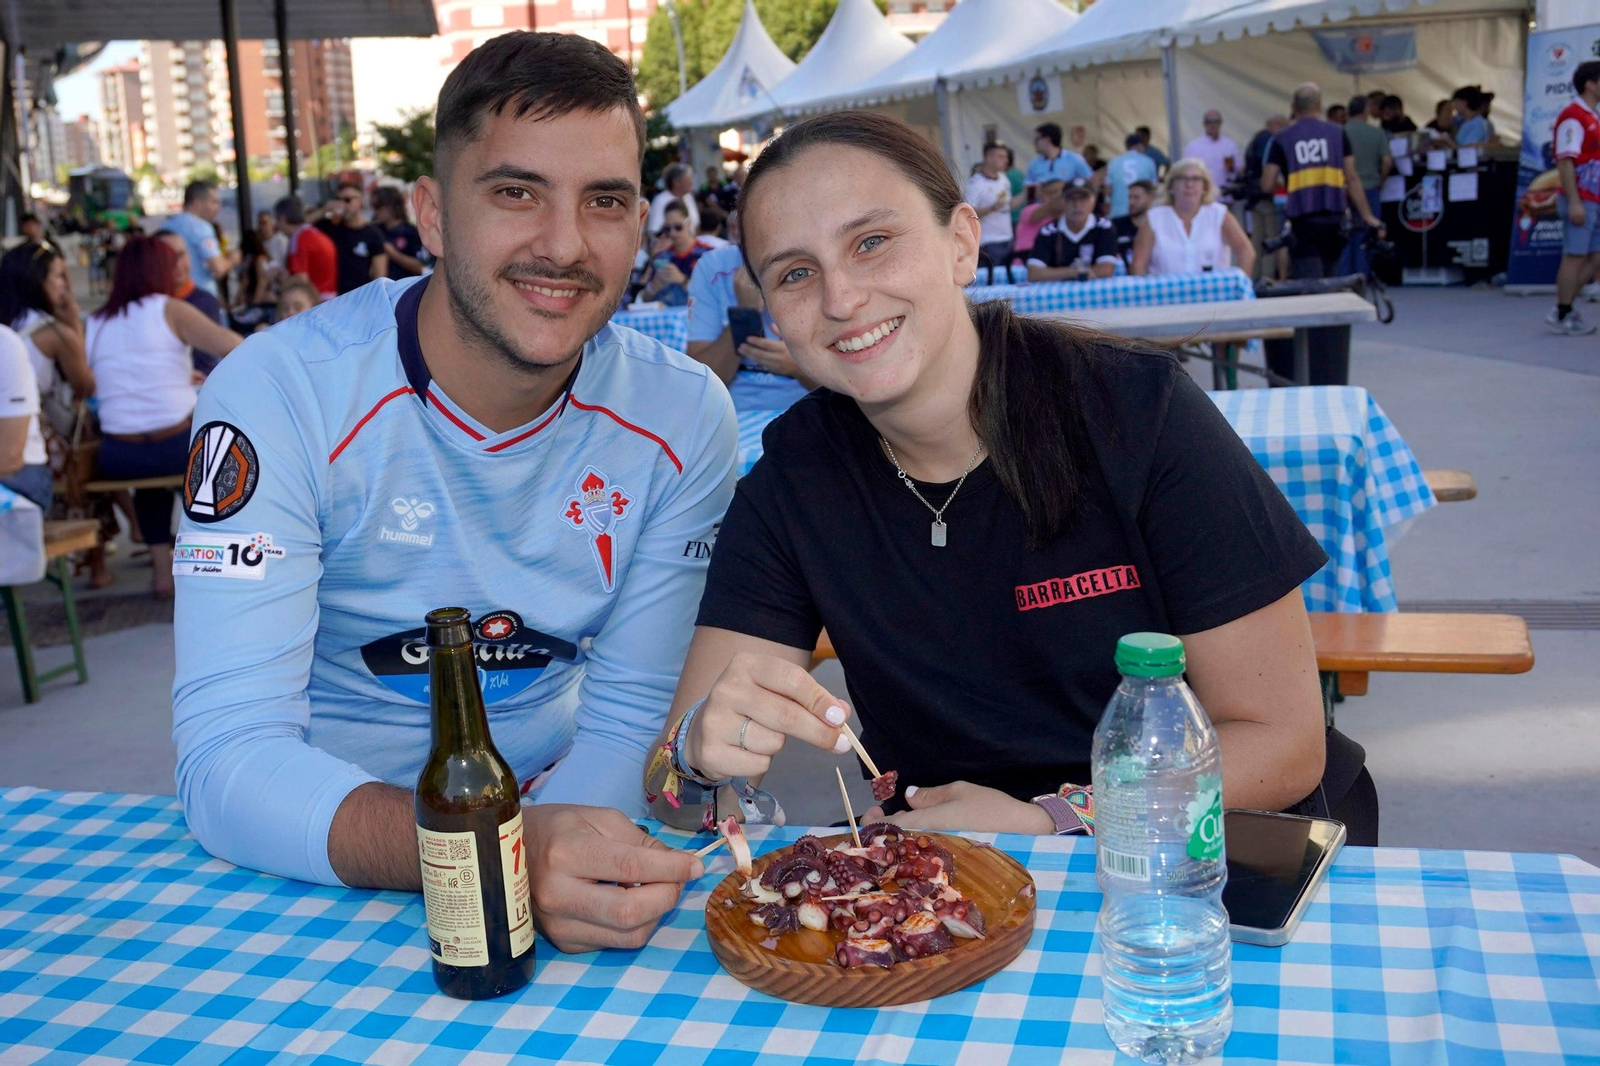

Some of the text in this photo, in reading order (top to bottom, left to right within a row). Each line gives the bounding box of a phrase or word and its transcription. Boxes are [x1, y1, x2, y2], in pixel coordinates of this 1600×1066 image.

[1294, 138, 1328, 165] 021
[380, 526, 433, 546] hummel
[227, 543, 263, 567] 10
[201, 565, 222, 573] children
[1017, 568, 1138, 608] BARRACELTA
[463, 871, 471, 880] B
[516, 902, 527, 921] LA
